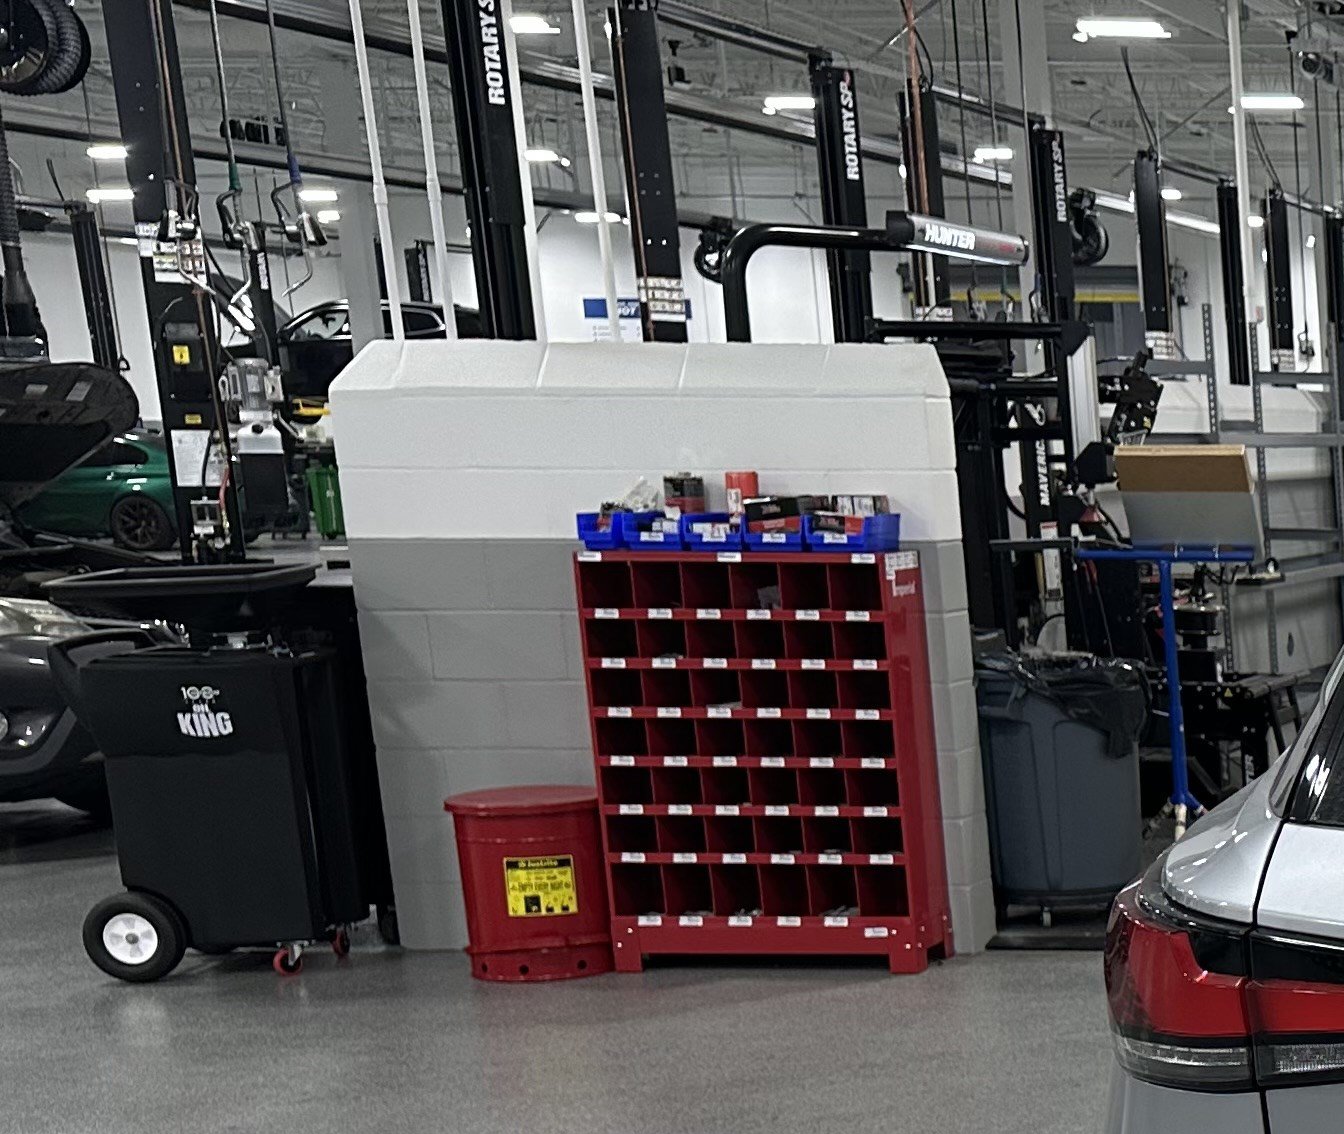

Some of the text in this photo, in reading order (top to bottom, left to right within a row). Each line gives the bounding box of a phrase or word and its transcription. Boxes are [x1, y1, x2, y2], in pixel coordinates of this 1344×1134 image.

[479, 11, 505, 105] ROTARY
[842, 108, 860, 180] ROTARY
[1053, 163, 1067, 222] ROTARY
[924, 222, 976, 250] HUNTER
[177, 711, 233, 737] KING
